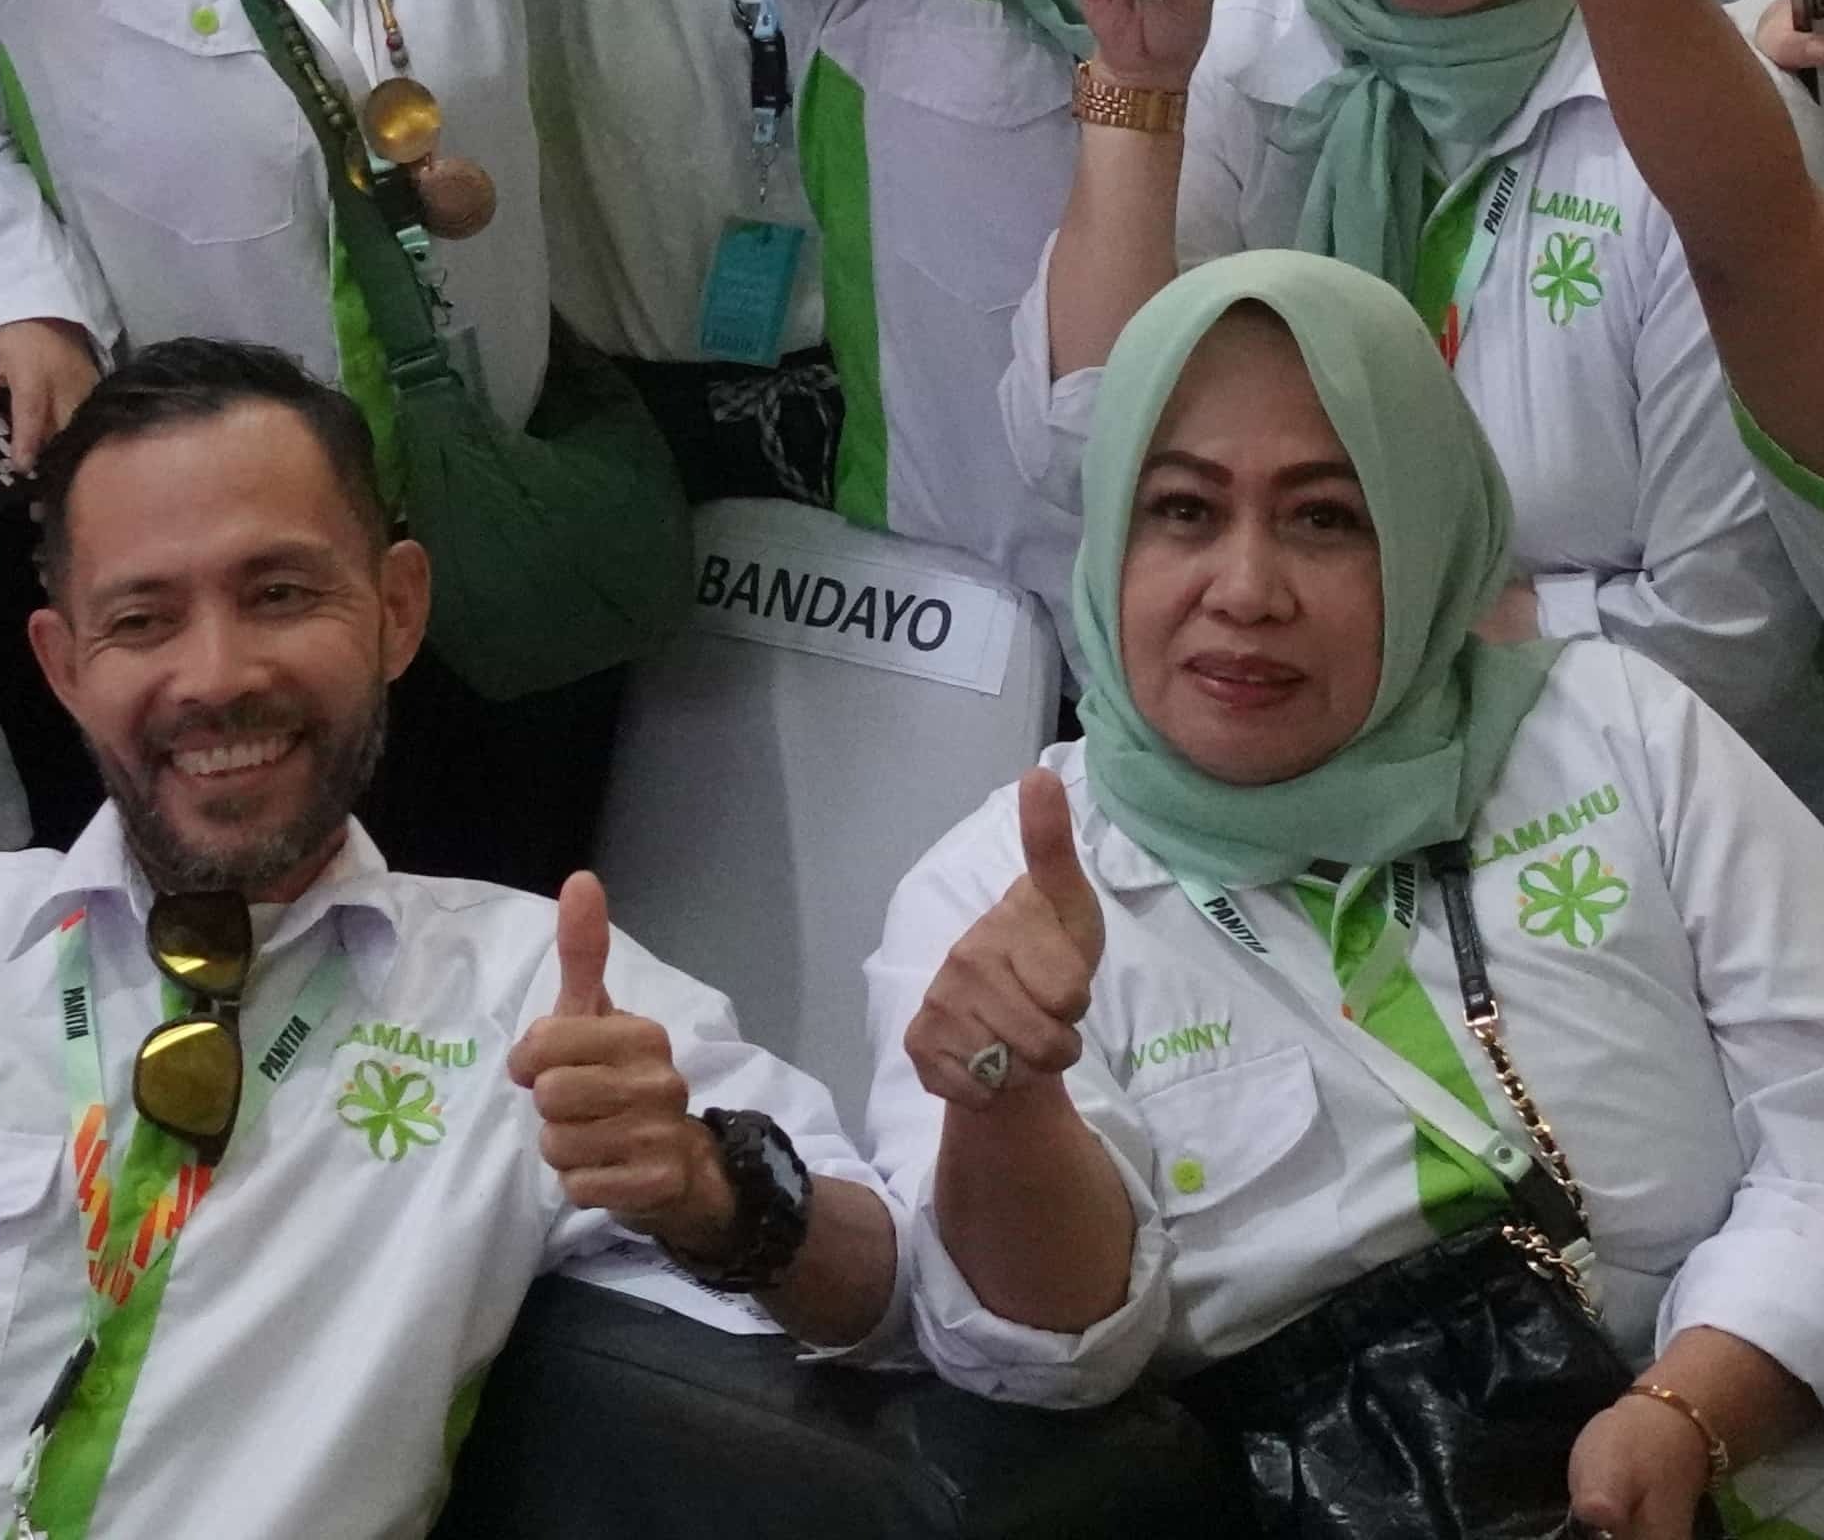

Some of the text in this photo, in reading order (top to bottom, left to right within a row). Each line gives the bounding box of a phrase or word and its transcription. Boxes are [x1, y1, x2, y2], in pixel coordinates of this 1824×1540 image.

[1484, 166, 1518, 235] PANITIA
[697, 555, 952, 651] BANDAYO
[1204, 897, 1270, 954] PANITIA
[62, 986, 89, 1041] PANITIA
[258, 1014, 312, 1082] PANITIA
